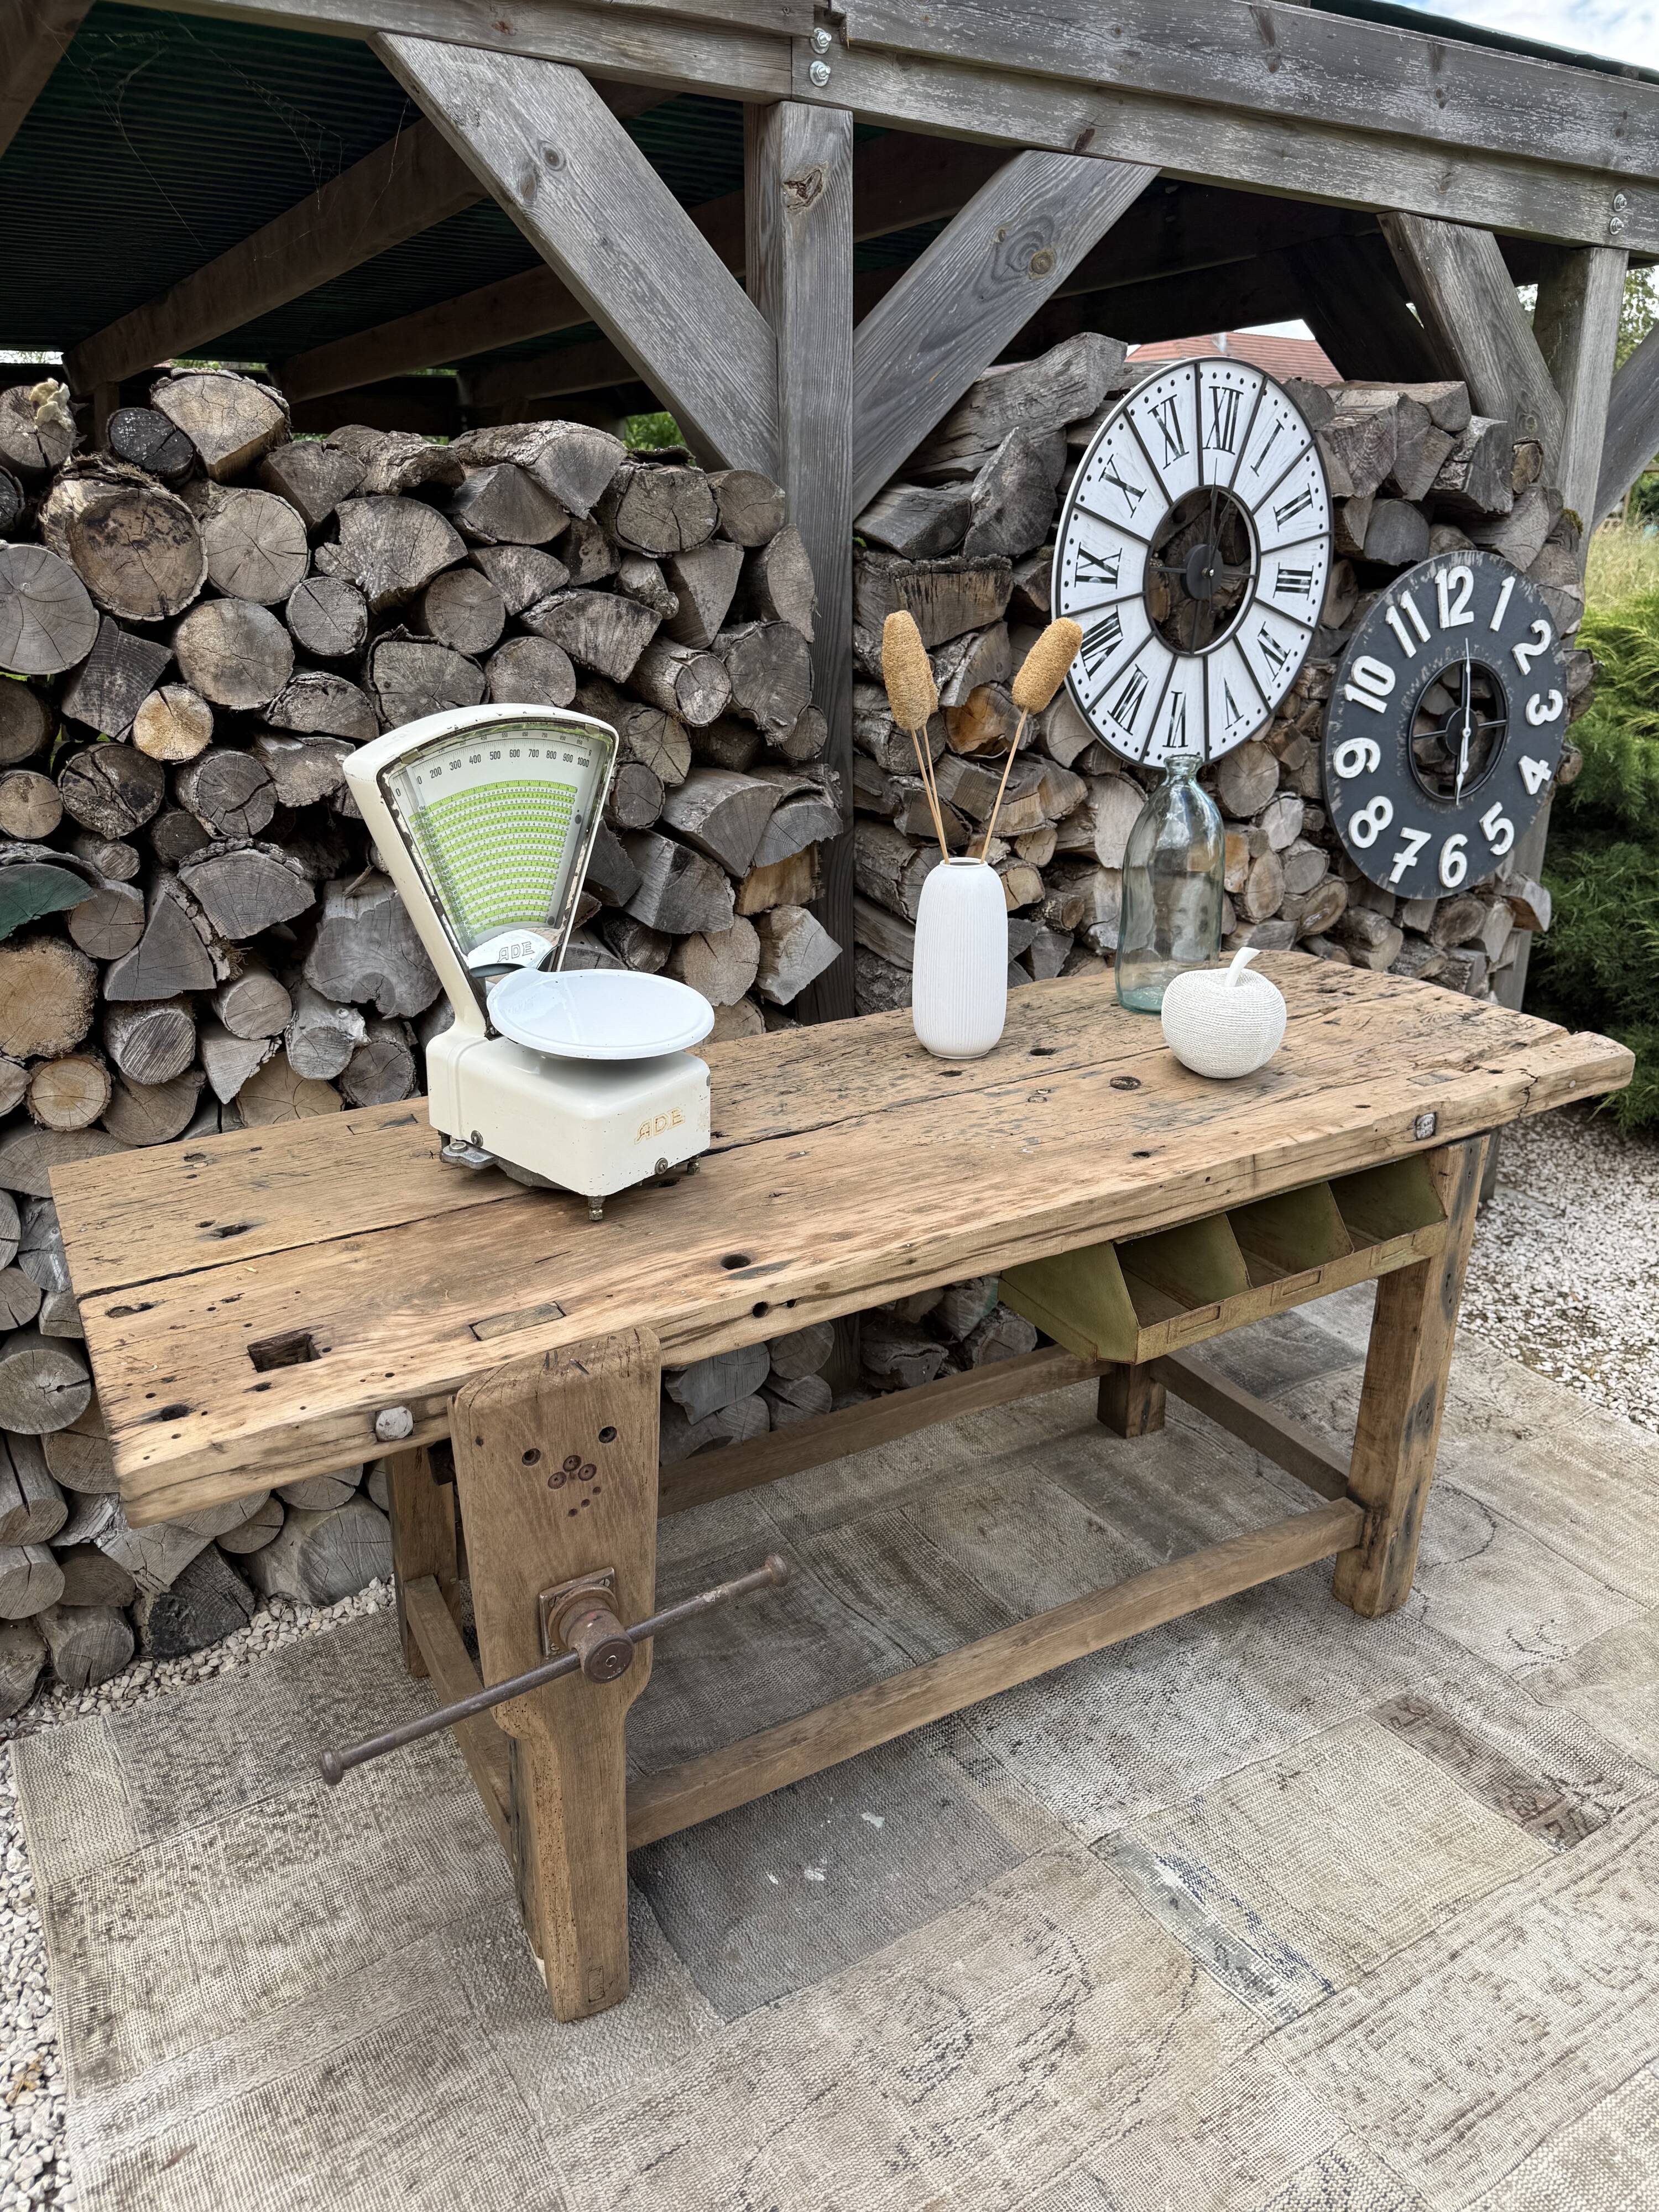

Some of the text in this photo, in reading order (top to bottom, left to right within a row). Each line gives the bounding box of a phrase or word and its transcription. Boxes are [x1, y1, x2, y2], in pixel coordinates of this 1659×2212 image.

[1147, 394, 1189, 470] XI
[1202, 386, 1244, 455] XII
[1251, 419, 1285, 476] I
[1100, 454, 1146, 518] X
[1274, 483, 1314, 532] II
[1075, 542, 1123, 588] IX
[1274, 562, 1314, 598] III
[1385, 590, 1431, 658] 11
[1434, 565, 1474, 629] 12
[1490, 576, 1516, 632] 1
[1258, 622, 1291, 681] IV
[1512, 619, 1552, 676] 2
[1107, 664, 1148, 735] VII
[1224, 678, 1244, 729] V
[1344, 655, 1396, 713] 10
[1526, 689, 1563, 726] 3
[1163, 691, 1189, 747] VI
[430, 767, 442, 779] 200
[450, 759, 462, 770] 300
[469, 754, 481, 764] 400
[490, 751, 500, 760] 500
[510, 749, 520, 758] 600
[529, 749, 539, 758] 700
[546, 750, 557, 759] 800
[563, 753, 573, 763] 900
[577, 757, 589, 768] 1000
[1333, 737, 1380, 779] 9
[1519, 755, 1552, 795] 4
[395, 788, 401, 797] 0
[1349, 795, 1394, 849] 8
[1479, 802, 1515, 855] 5
[1389, 827, 1432, 883] 7
[1439, 833, 1469, 888] 6
[497, 941, 535, 962] ADE
[634, 1107, 685, 1145] ADE
